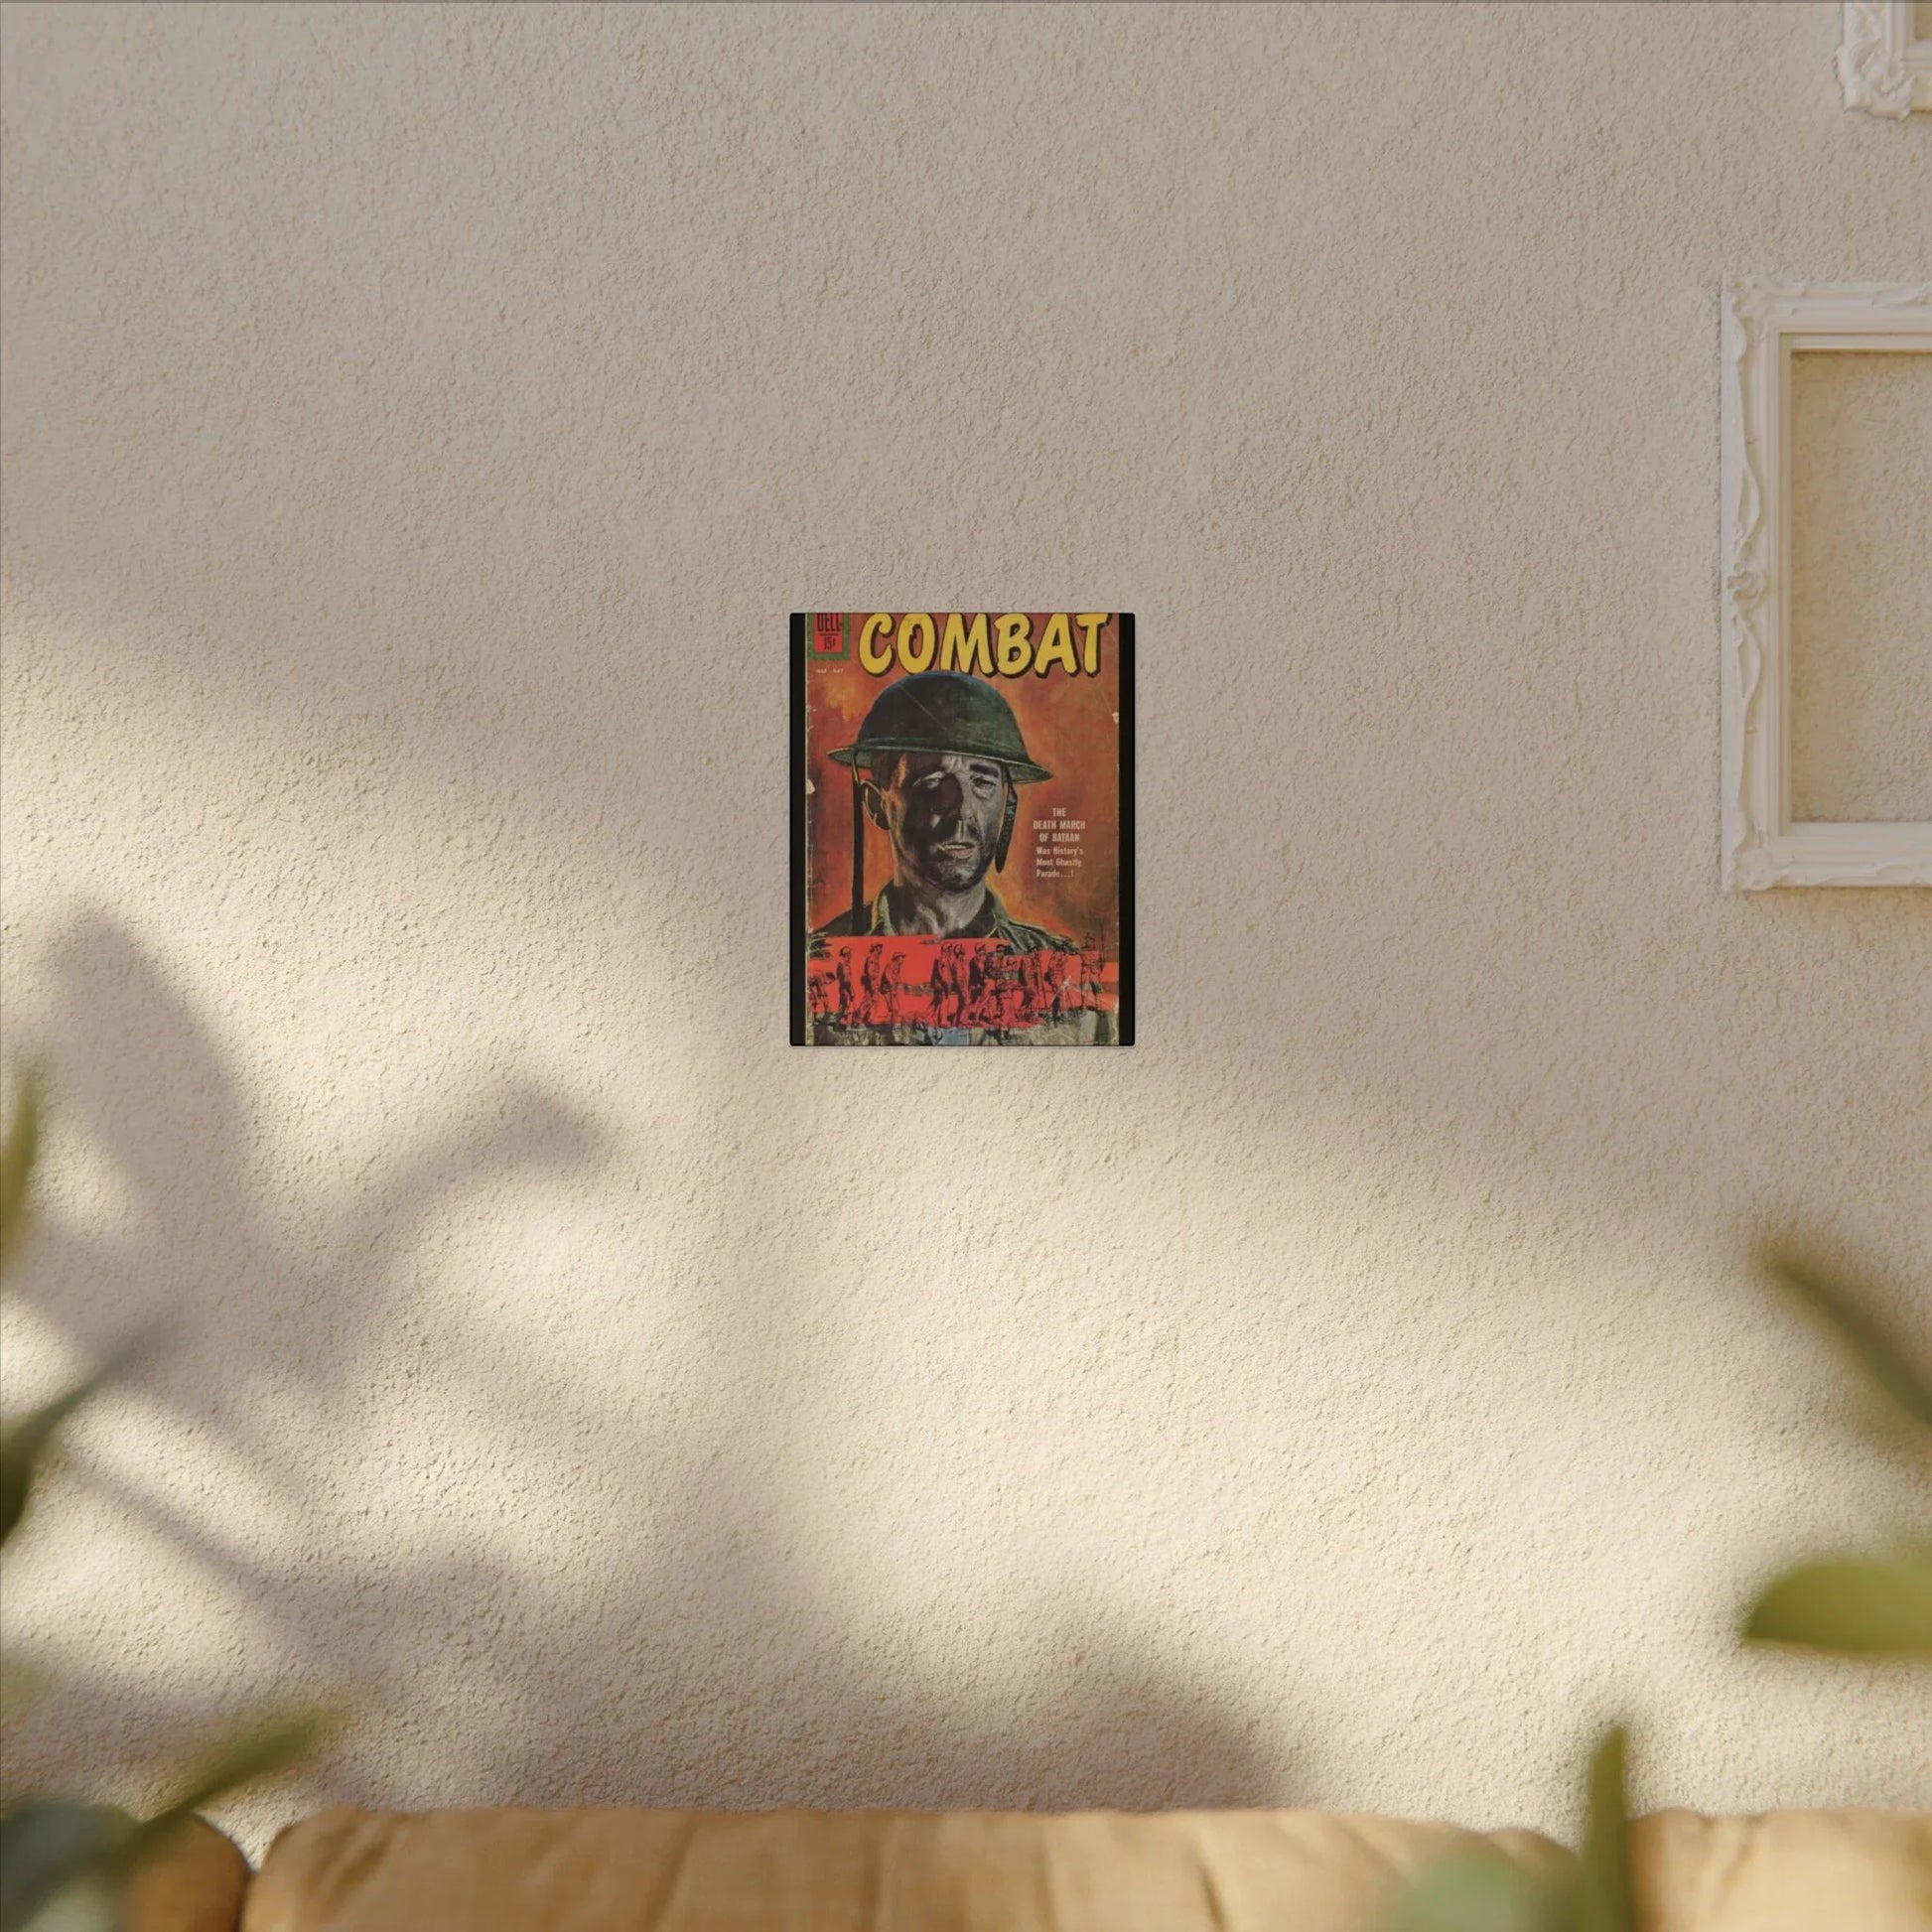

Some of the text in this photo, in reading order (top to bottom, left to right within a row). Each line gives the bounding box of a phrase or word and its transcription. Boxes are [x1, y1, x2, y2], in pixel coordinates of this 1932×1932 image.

[859, 613, 1111, 677] COMBAT
[1052, 807, 1066, 817] THE
[1033, 820, 1086, 830] DEATH MARCH
[1039, 833, 1080, 842] OF BATAAN
[1053, 847, 1083, 856] History's
[1055, 858, 1082, 867] Ghastly
